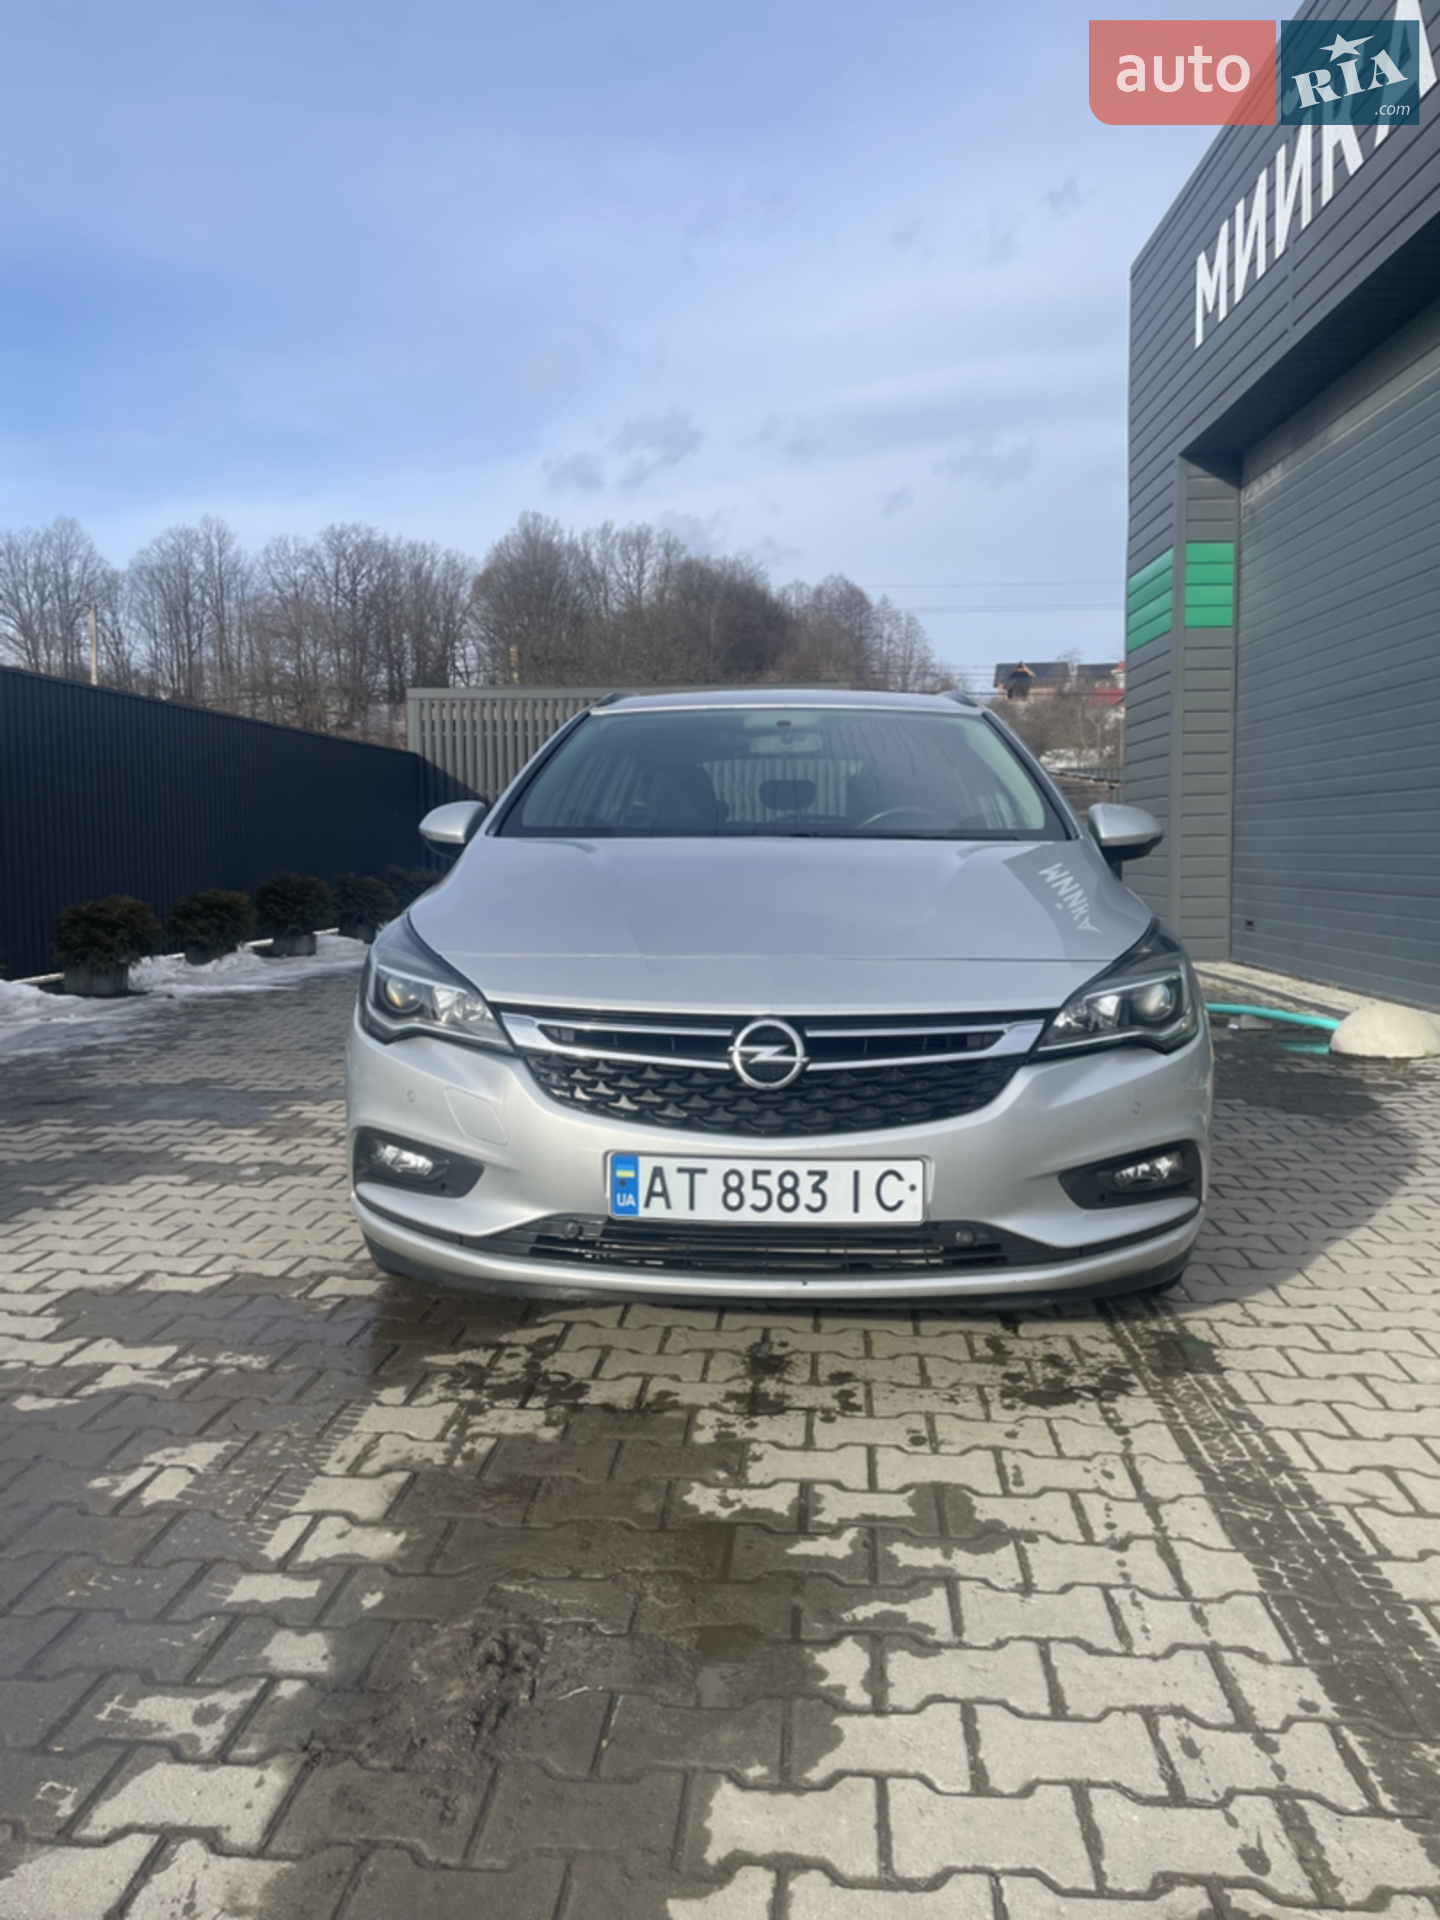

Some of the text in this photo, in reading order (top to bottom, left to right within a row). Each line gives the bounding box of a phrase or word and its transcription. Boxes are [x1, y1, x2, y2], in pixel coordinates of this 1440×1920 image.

[616, 1192, 637, 1207] UA
[643, 1165, 905, 1214] AT 8583 IC
